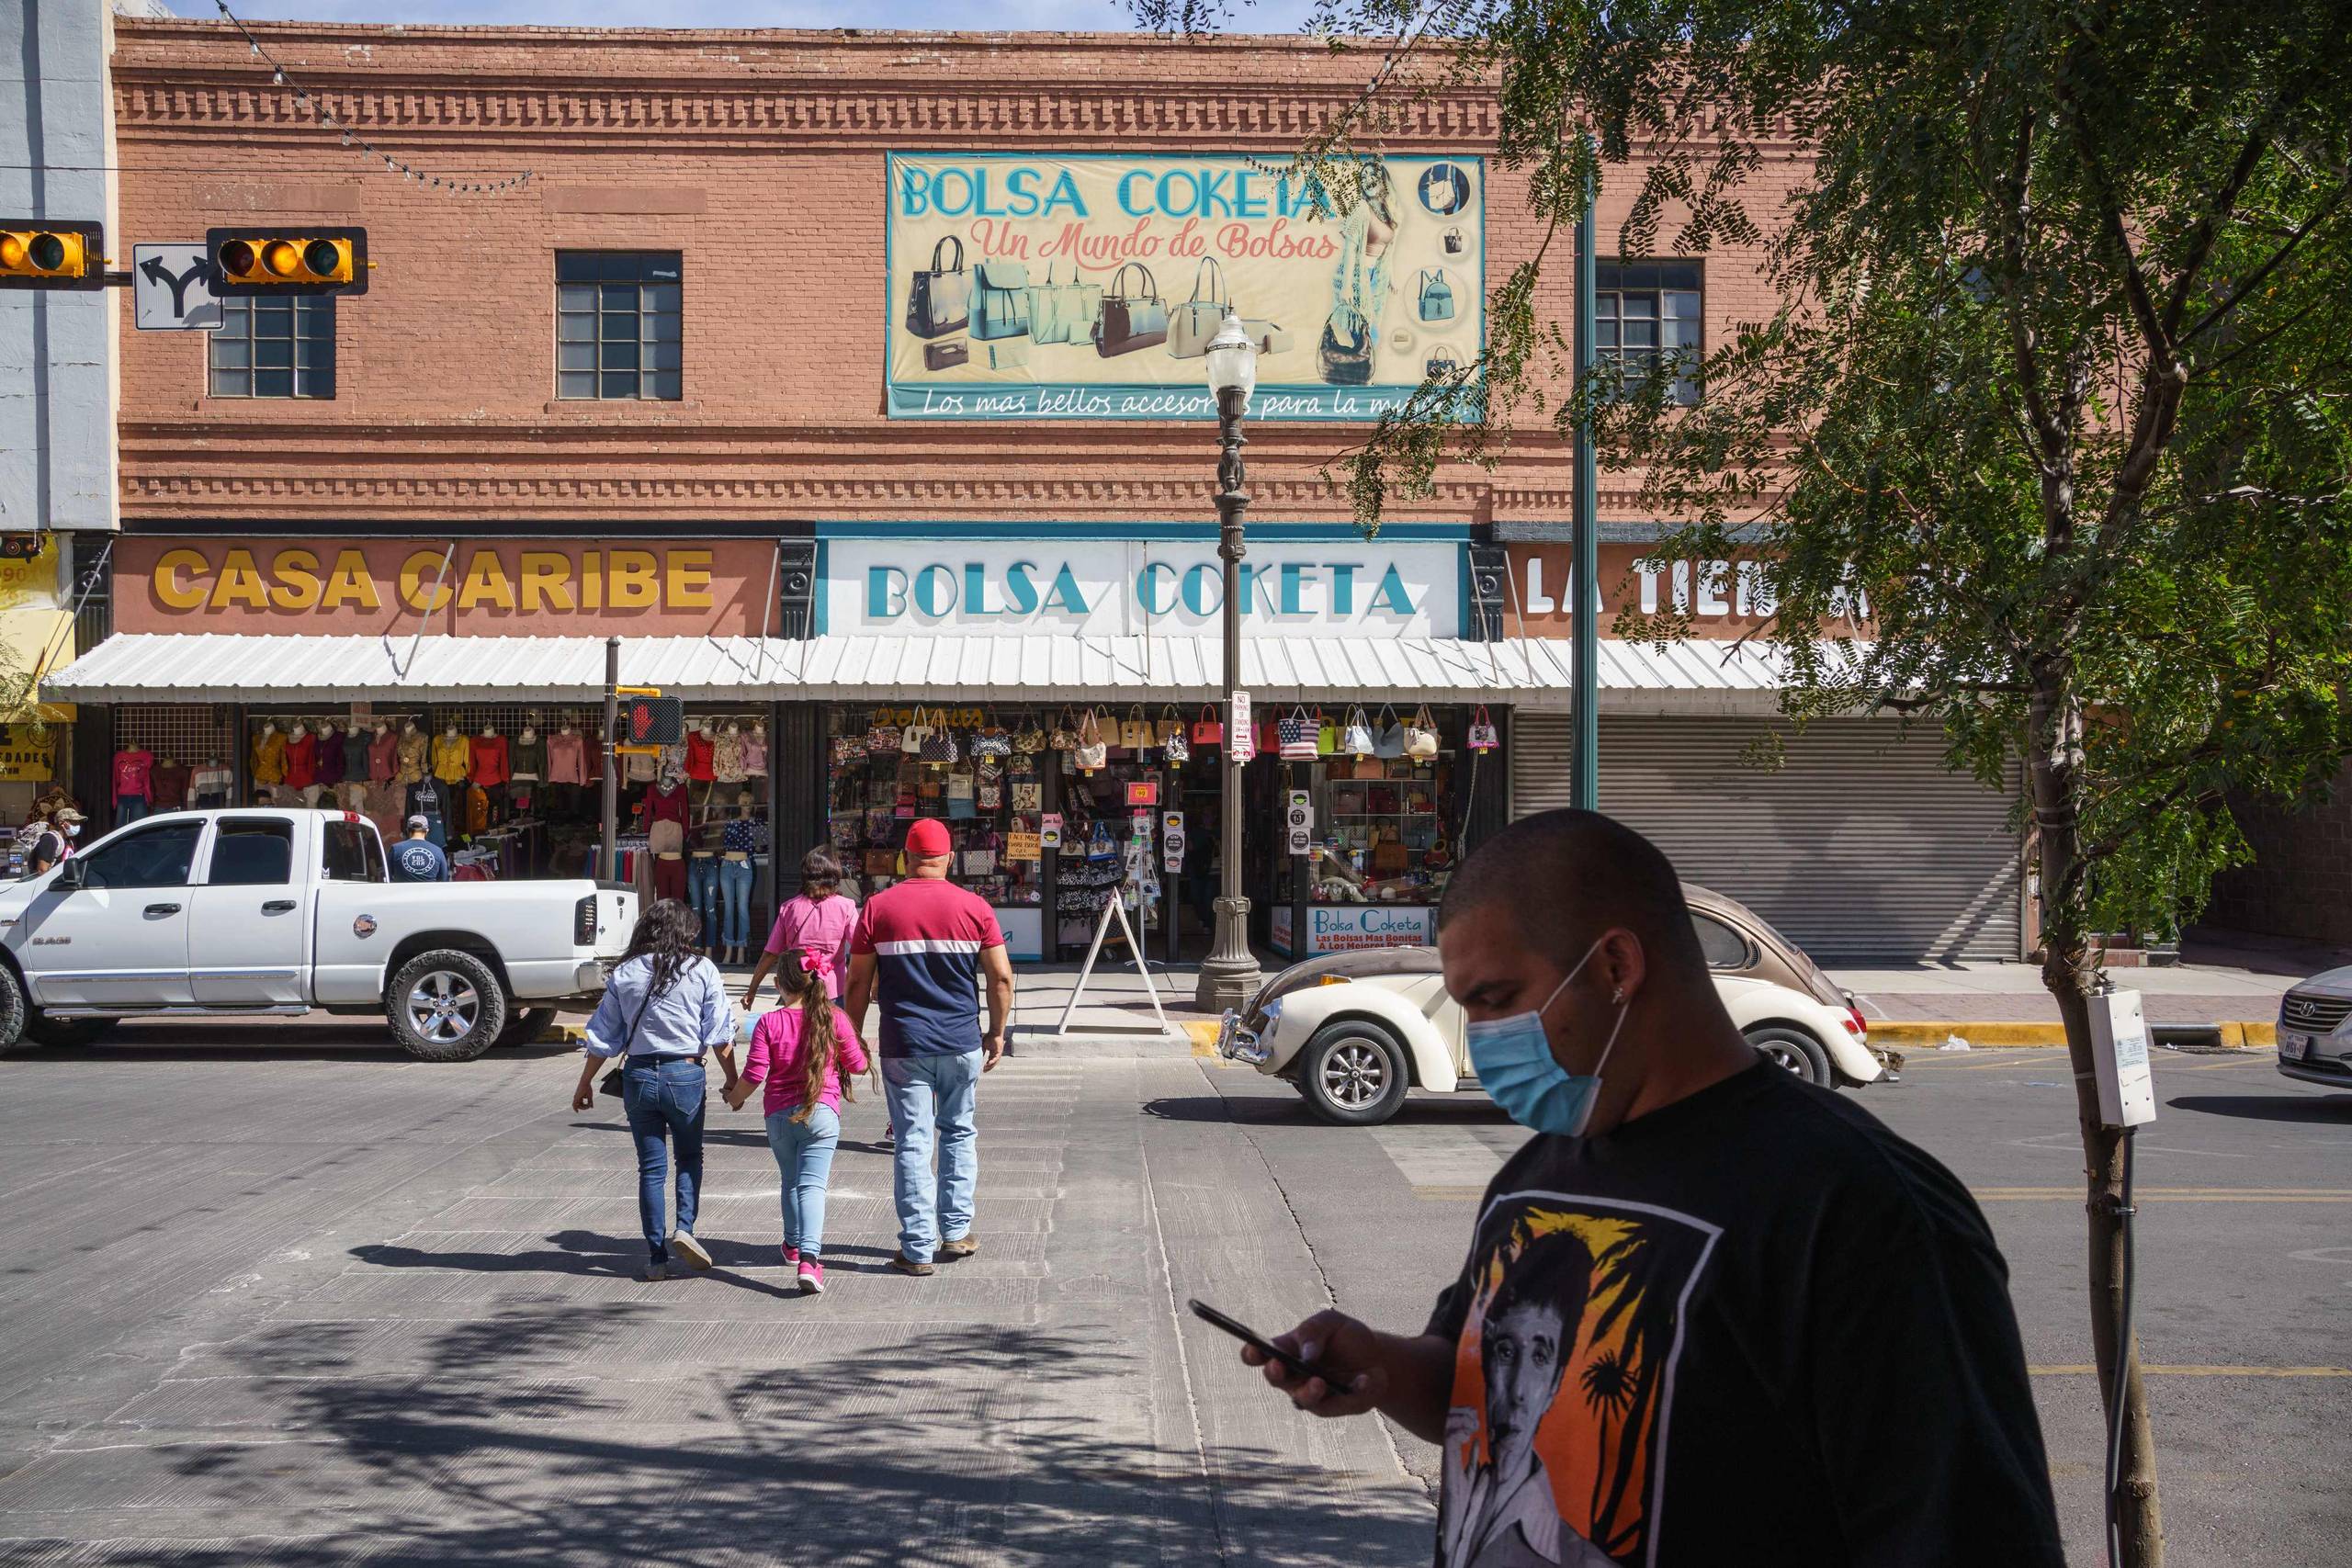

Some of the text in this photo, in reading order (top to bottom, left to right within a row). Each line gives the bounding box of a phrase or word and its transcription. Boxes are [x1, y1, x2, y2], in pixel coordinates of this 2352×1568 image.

[901, 167, 1090, 218] BOLSA
[970, 216, 1339, 270] Un Mundo de Bolsas
[922, 389, 964, 414] Los
[975, 394, 1026, 413] mas
[1036, 388, 1111, 414] bellos
[1260, 394, 1323, 421] para
[1333, 389, 1359, 413] la
[154, 549, 714, 610] CASA CARIBE
[867, 561, 1417, 617] BOLSA COKETA
[1313, 908, 1421, 934] Bolsa Coketa
[1316, 933, 1422, 942] Las Bolsas Mas Bonitas
